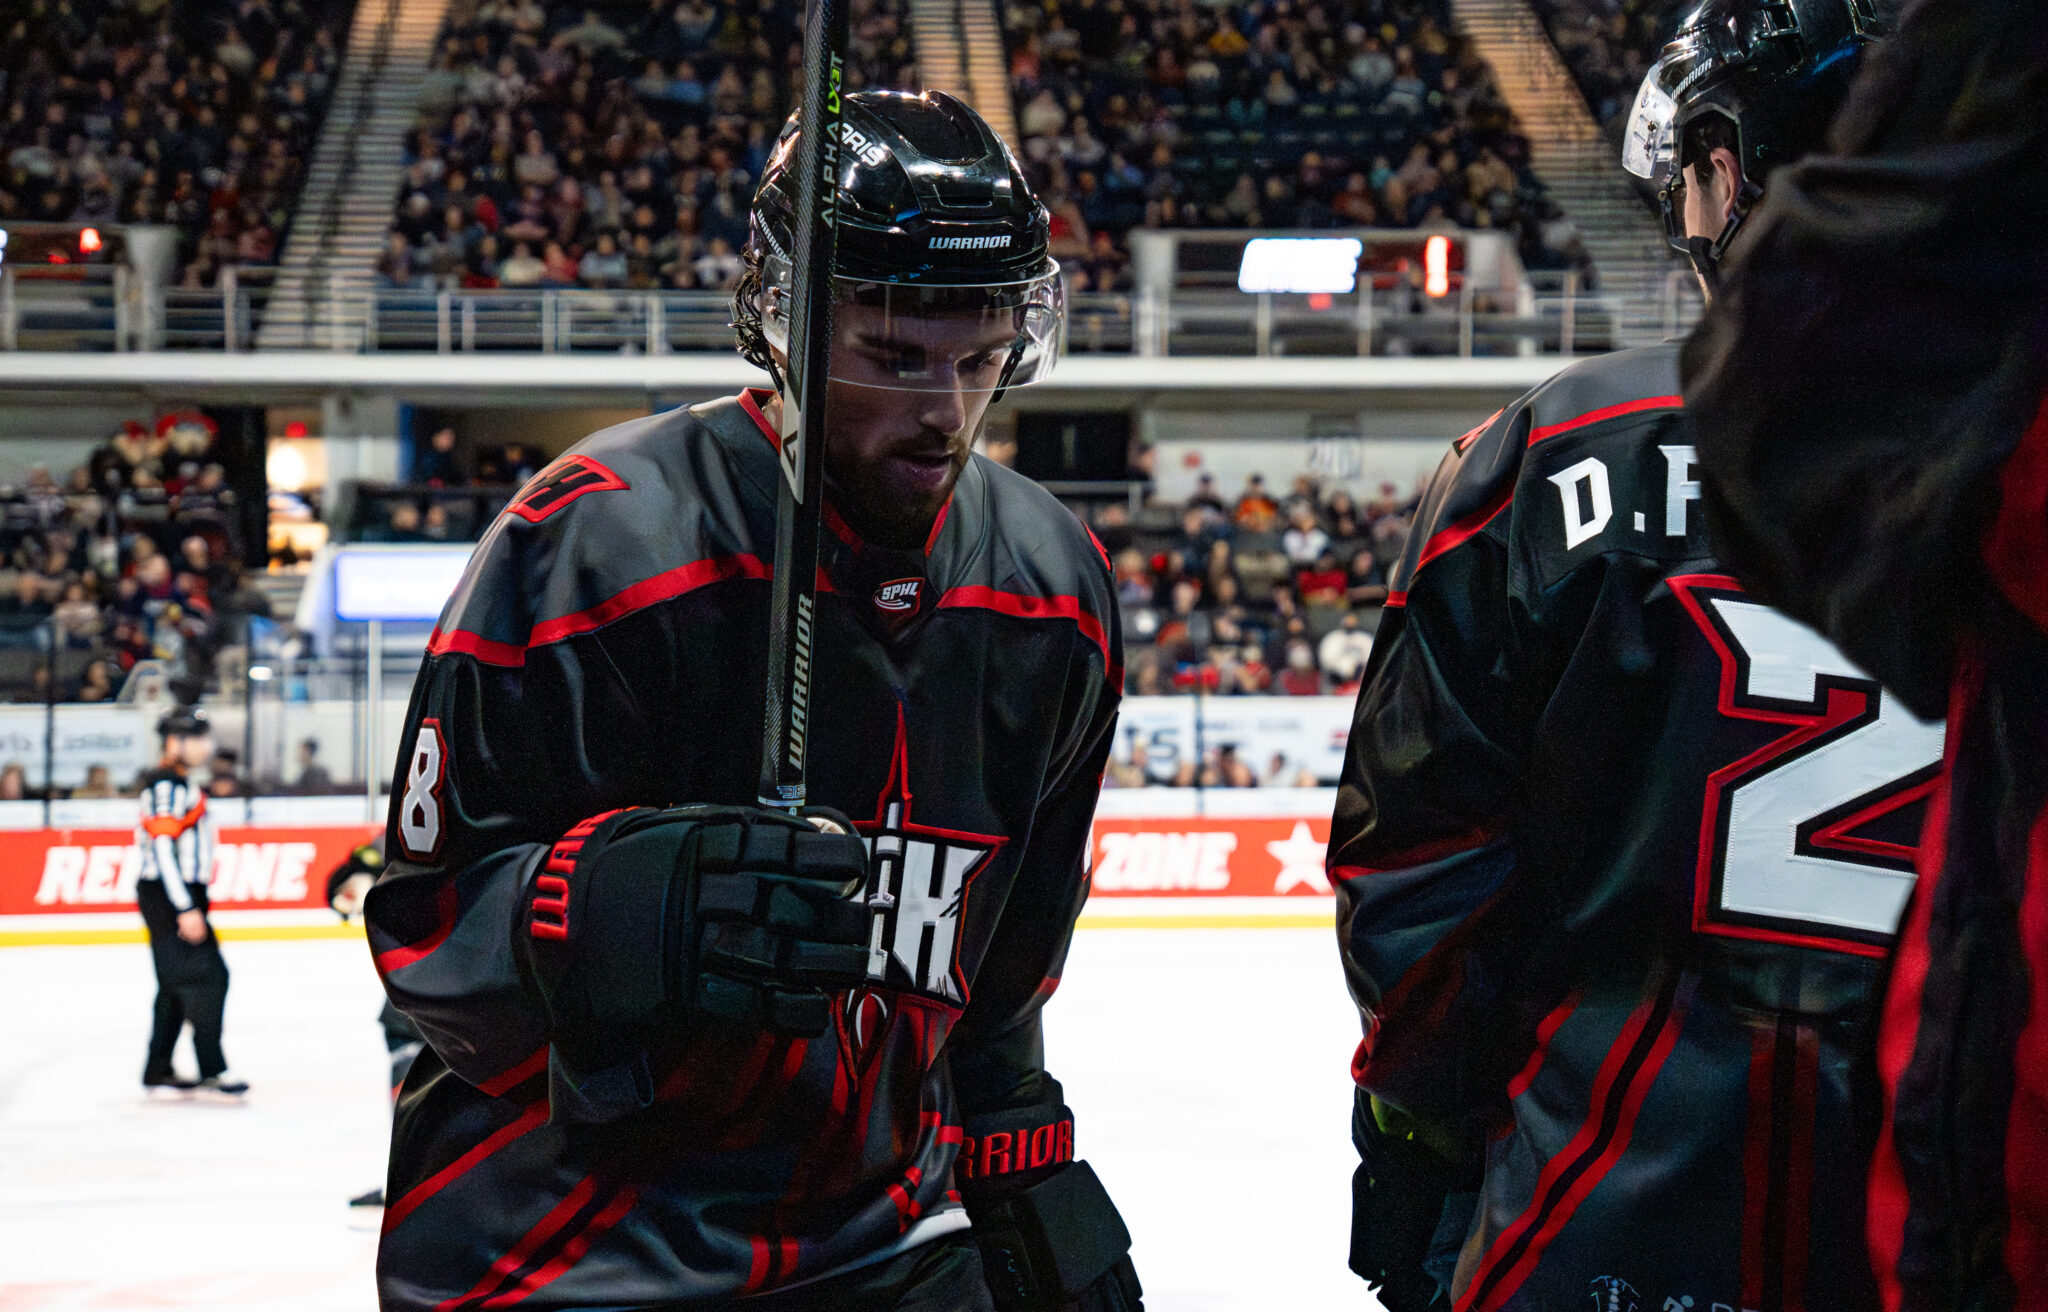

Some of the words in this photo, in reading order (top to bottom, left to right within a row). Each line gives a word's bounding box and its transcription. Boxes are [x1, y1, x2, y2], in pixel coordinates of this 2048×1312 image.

[1671, 57, 1713, 101] WARRIOR
[820, 121, 841, 229] ALPHA
[928, 235, 1012, 250] WARRIOR
[881, 581, 919, 601] SPHL
[788, 593, 813, 770] WARRIOR
[400, 722, 444, 857] 8
[209, 841, 317, 902] ONE
[1092, 831, 1238, 892] ZONE
[958, 1119, 1073, 1179] RRIOR
